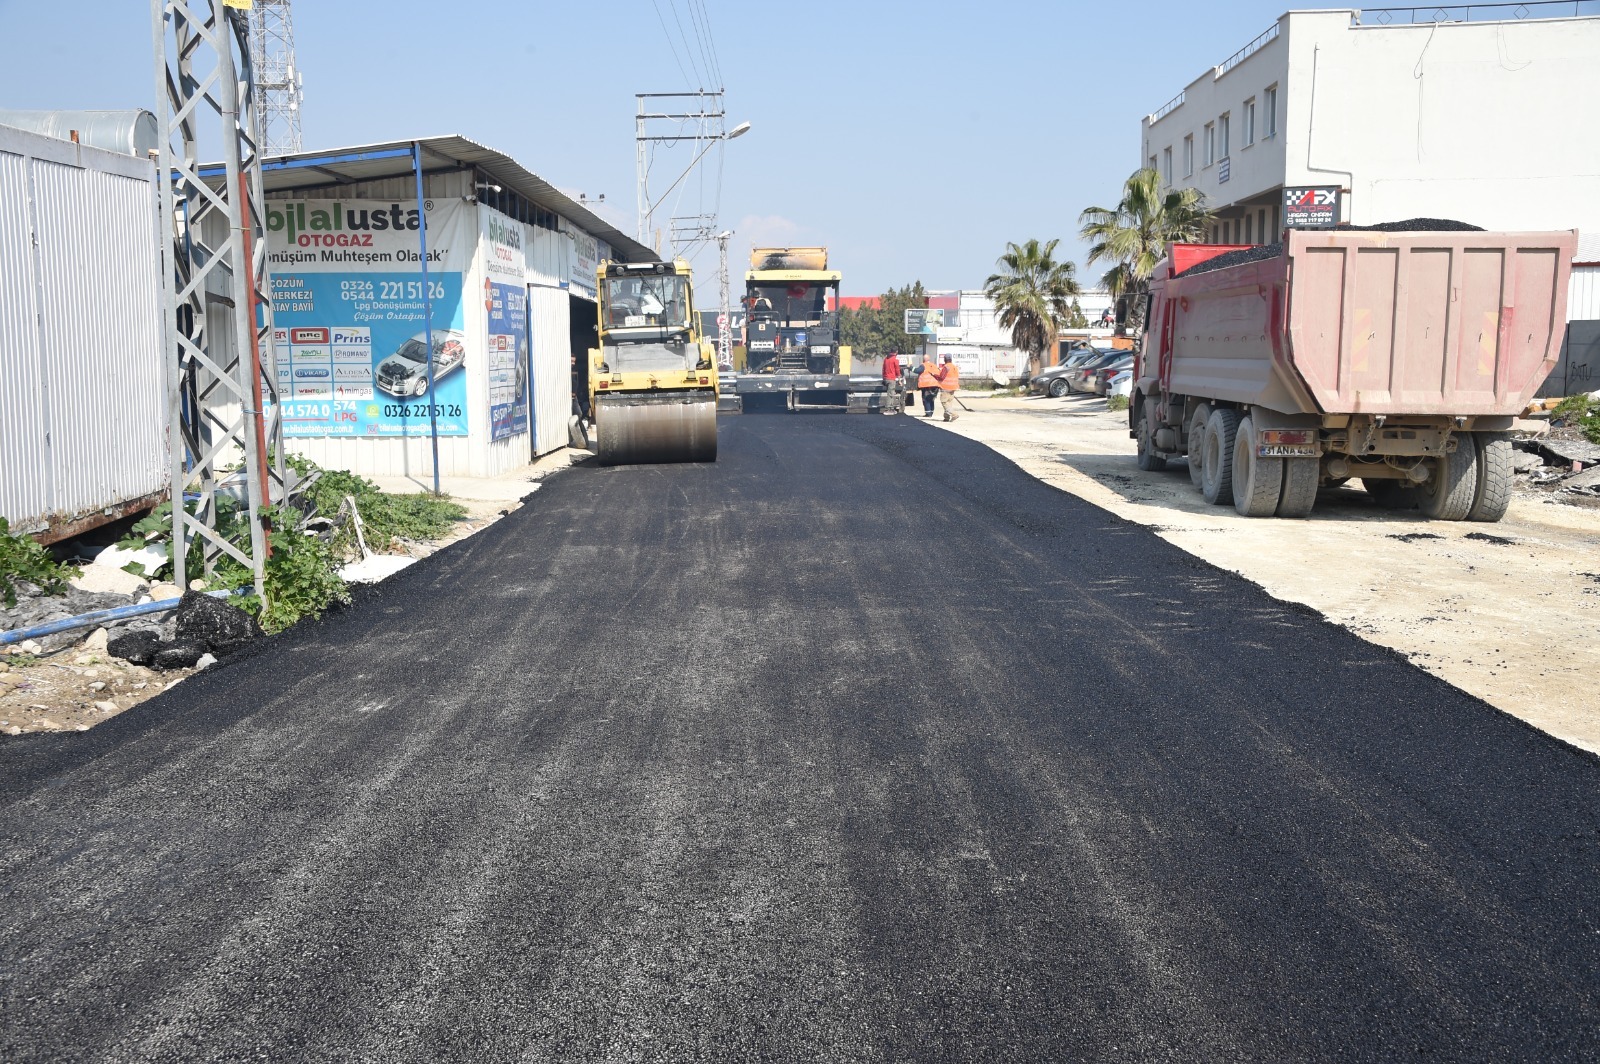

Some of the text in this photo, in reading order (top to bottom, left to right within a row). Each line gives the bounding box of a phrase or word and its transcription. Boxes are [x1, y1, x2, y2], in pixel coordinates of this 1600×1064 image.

[1297, 190, 1336, 205] AFX
[298, 234, 374, 247] OTOGAZ
[321, 249, 392, 266] Muhteşem
[340, 281, 374, 290] 0326
[380, 282, 445, 299] 221 51 26
[341, 291, 375, 301] 0544
[354, 302, 370, 311] Lpg
[333, 333, 371, 343] Prins
[297, 405, 318, 417] 574
[321, 404, 330, 417] 0
[333, 400, 357, 411] 574
[384, 404, 411, 417] 0326
[413, 404, 431, 417] 221
[448, 404, 462, 417] 26
[334, 412, 357, 422] LPG
[1266, 446, 1275, 455] 31
[1276, 446, 1295, 455] ANA
